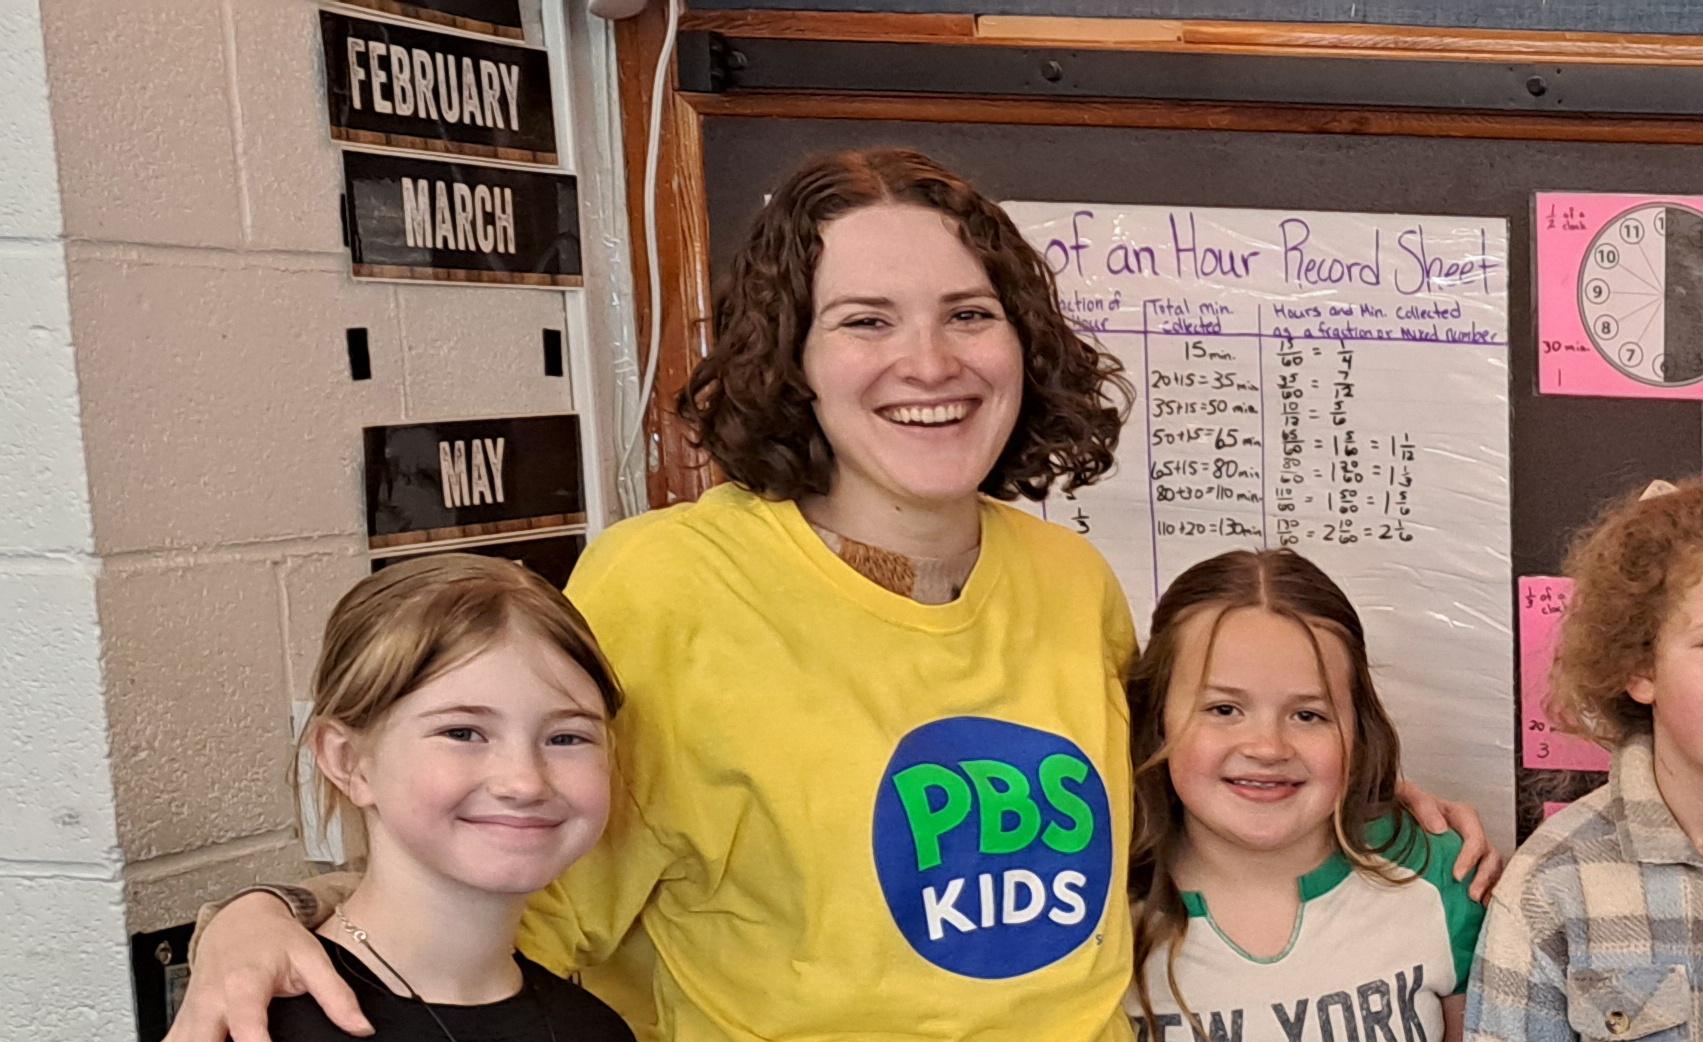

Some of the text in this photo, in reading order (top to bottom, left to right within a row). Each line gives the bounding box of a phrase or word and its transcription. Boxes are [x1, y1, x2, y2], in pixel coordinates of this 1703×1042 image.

[346, 37, 520, 131] FEBRUARY
[402, 177, 516, 254] MARCH
[1624, 225, 1640, 239] 11
[1045, 210, 1499, 295] of an Hour Record Sheet
[1598, 249, 1616, 264] 10
[1592, 285, 1602, 299] 9
[1147, 300, 1190, 316] Total
[1273, 303, 1322, 319] Hours
[1329, 305, 1353, 317] and
[1319, 321, 1373, 342] fraction
[1601, 321, 1611, 335] 8
[1185, 341, 1207, 361] 15
[1626, 349, 1635, 362] 7
[439, 437, 505, 509] MAY
[892, 753, 1095, 872] PBS
[922, 869, 1087, 941] KIDS
